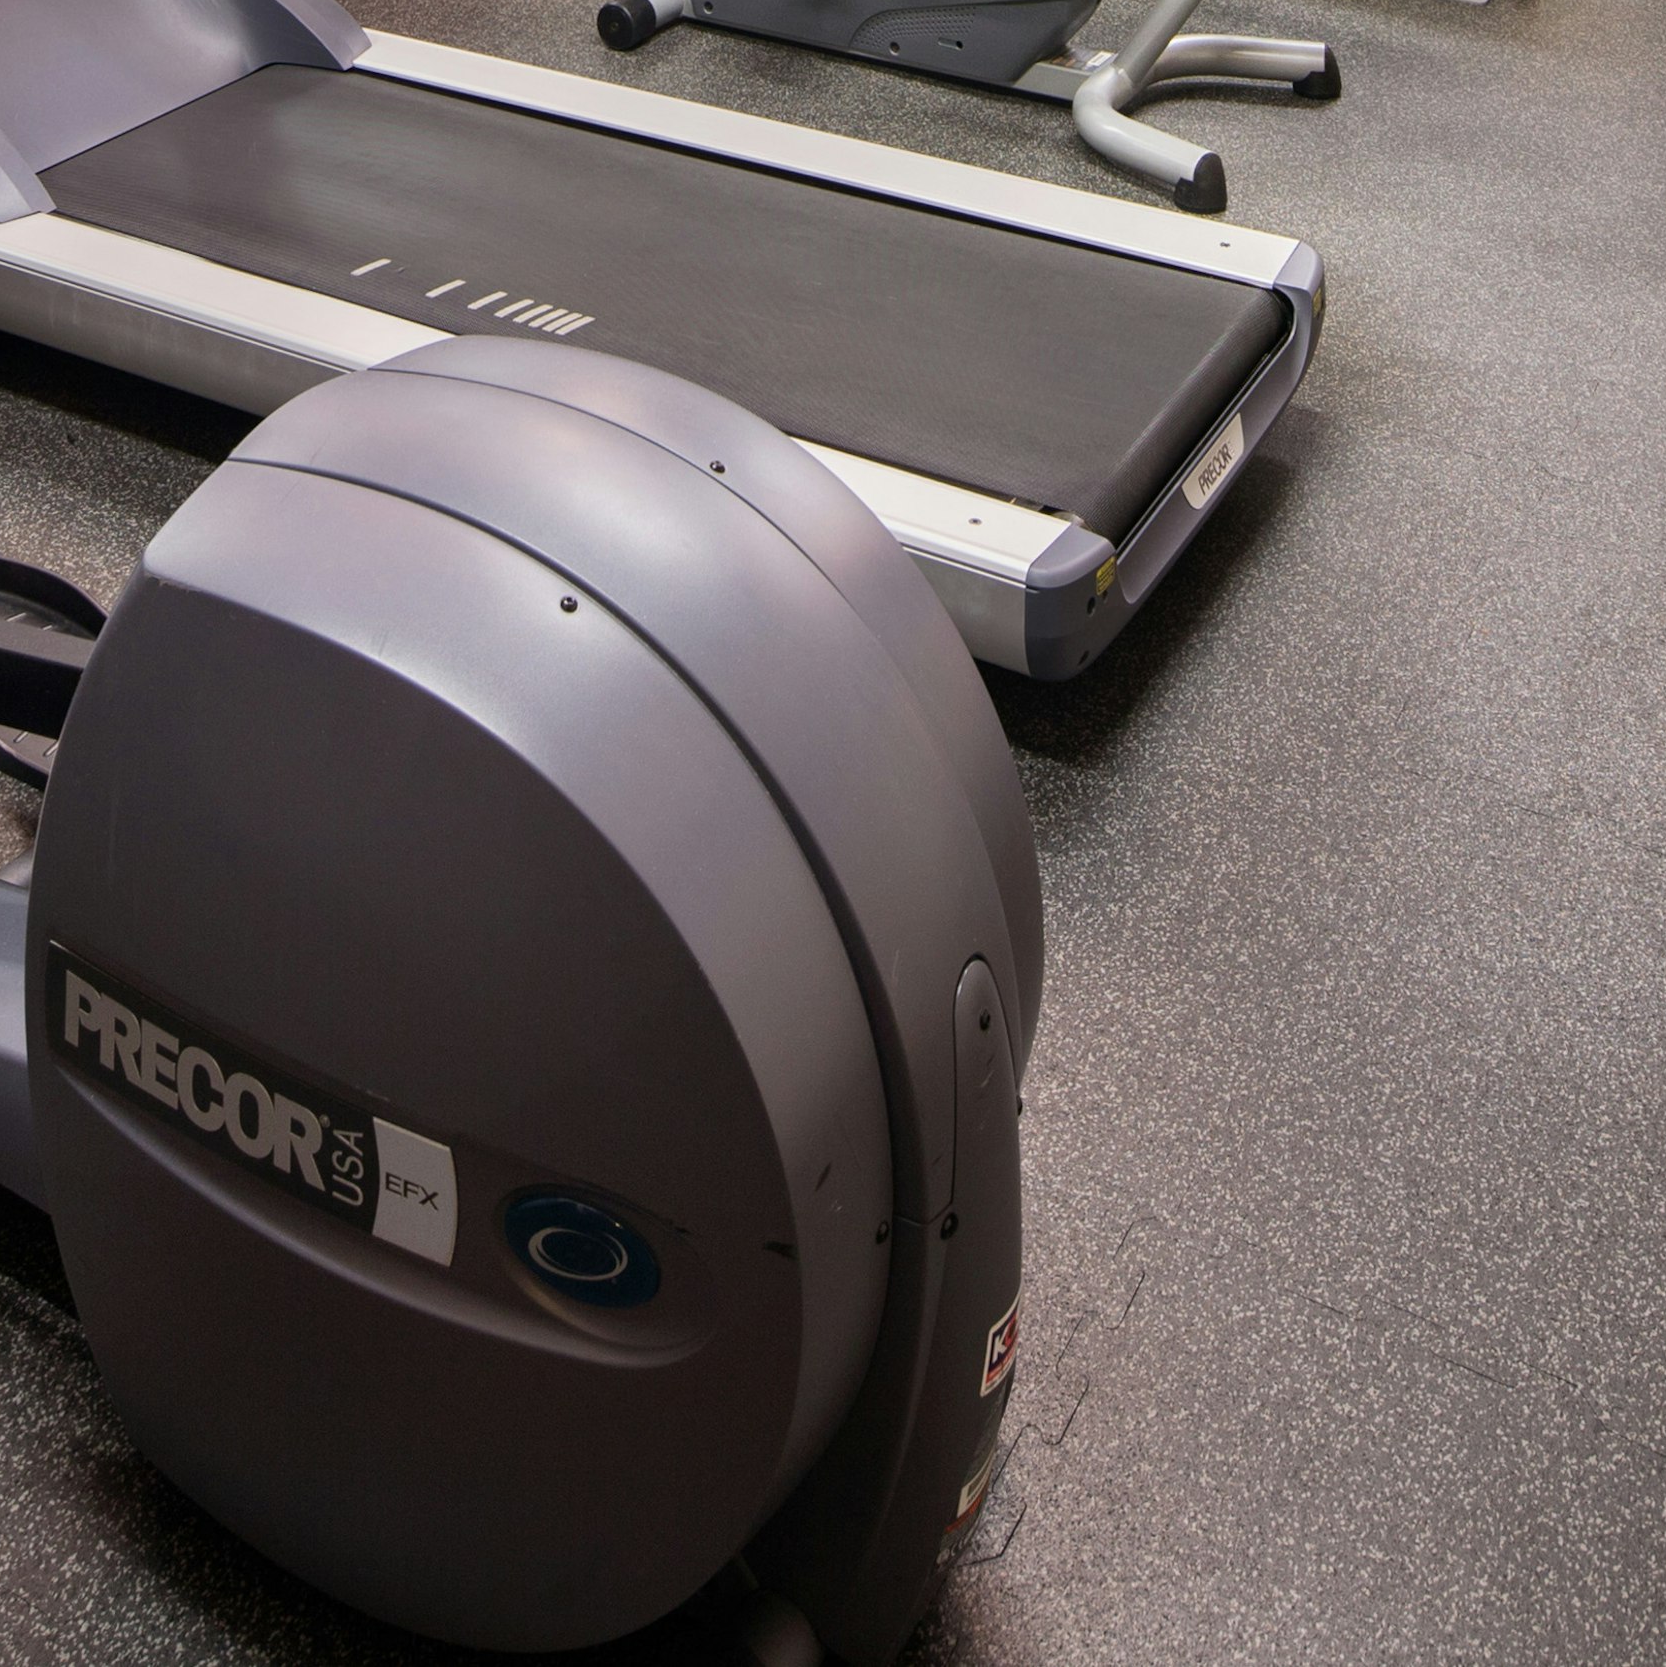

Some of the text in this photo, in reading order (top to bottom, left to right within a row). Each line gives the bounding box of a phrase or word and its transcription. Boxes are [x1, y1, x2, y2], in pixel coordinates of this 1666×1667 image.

[1197, 442, 1233, 496] PRECOR
[64, 969, 364, 1207] PRECOR USA
[384, 1171, 440, 1211] EFX
